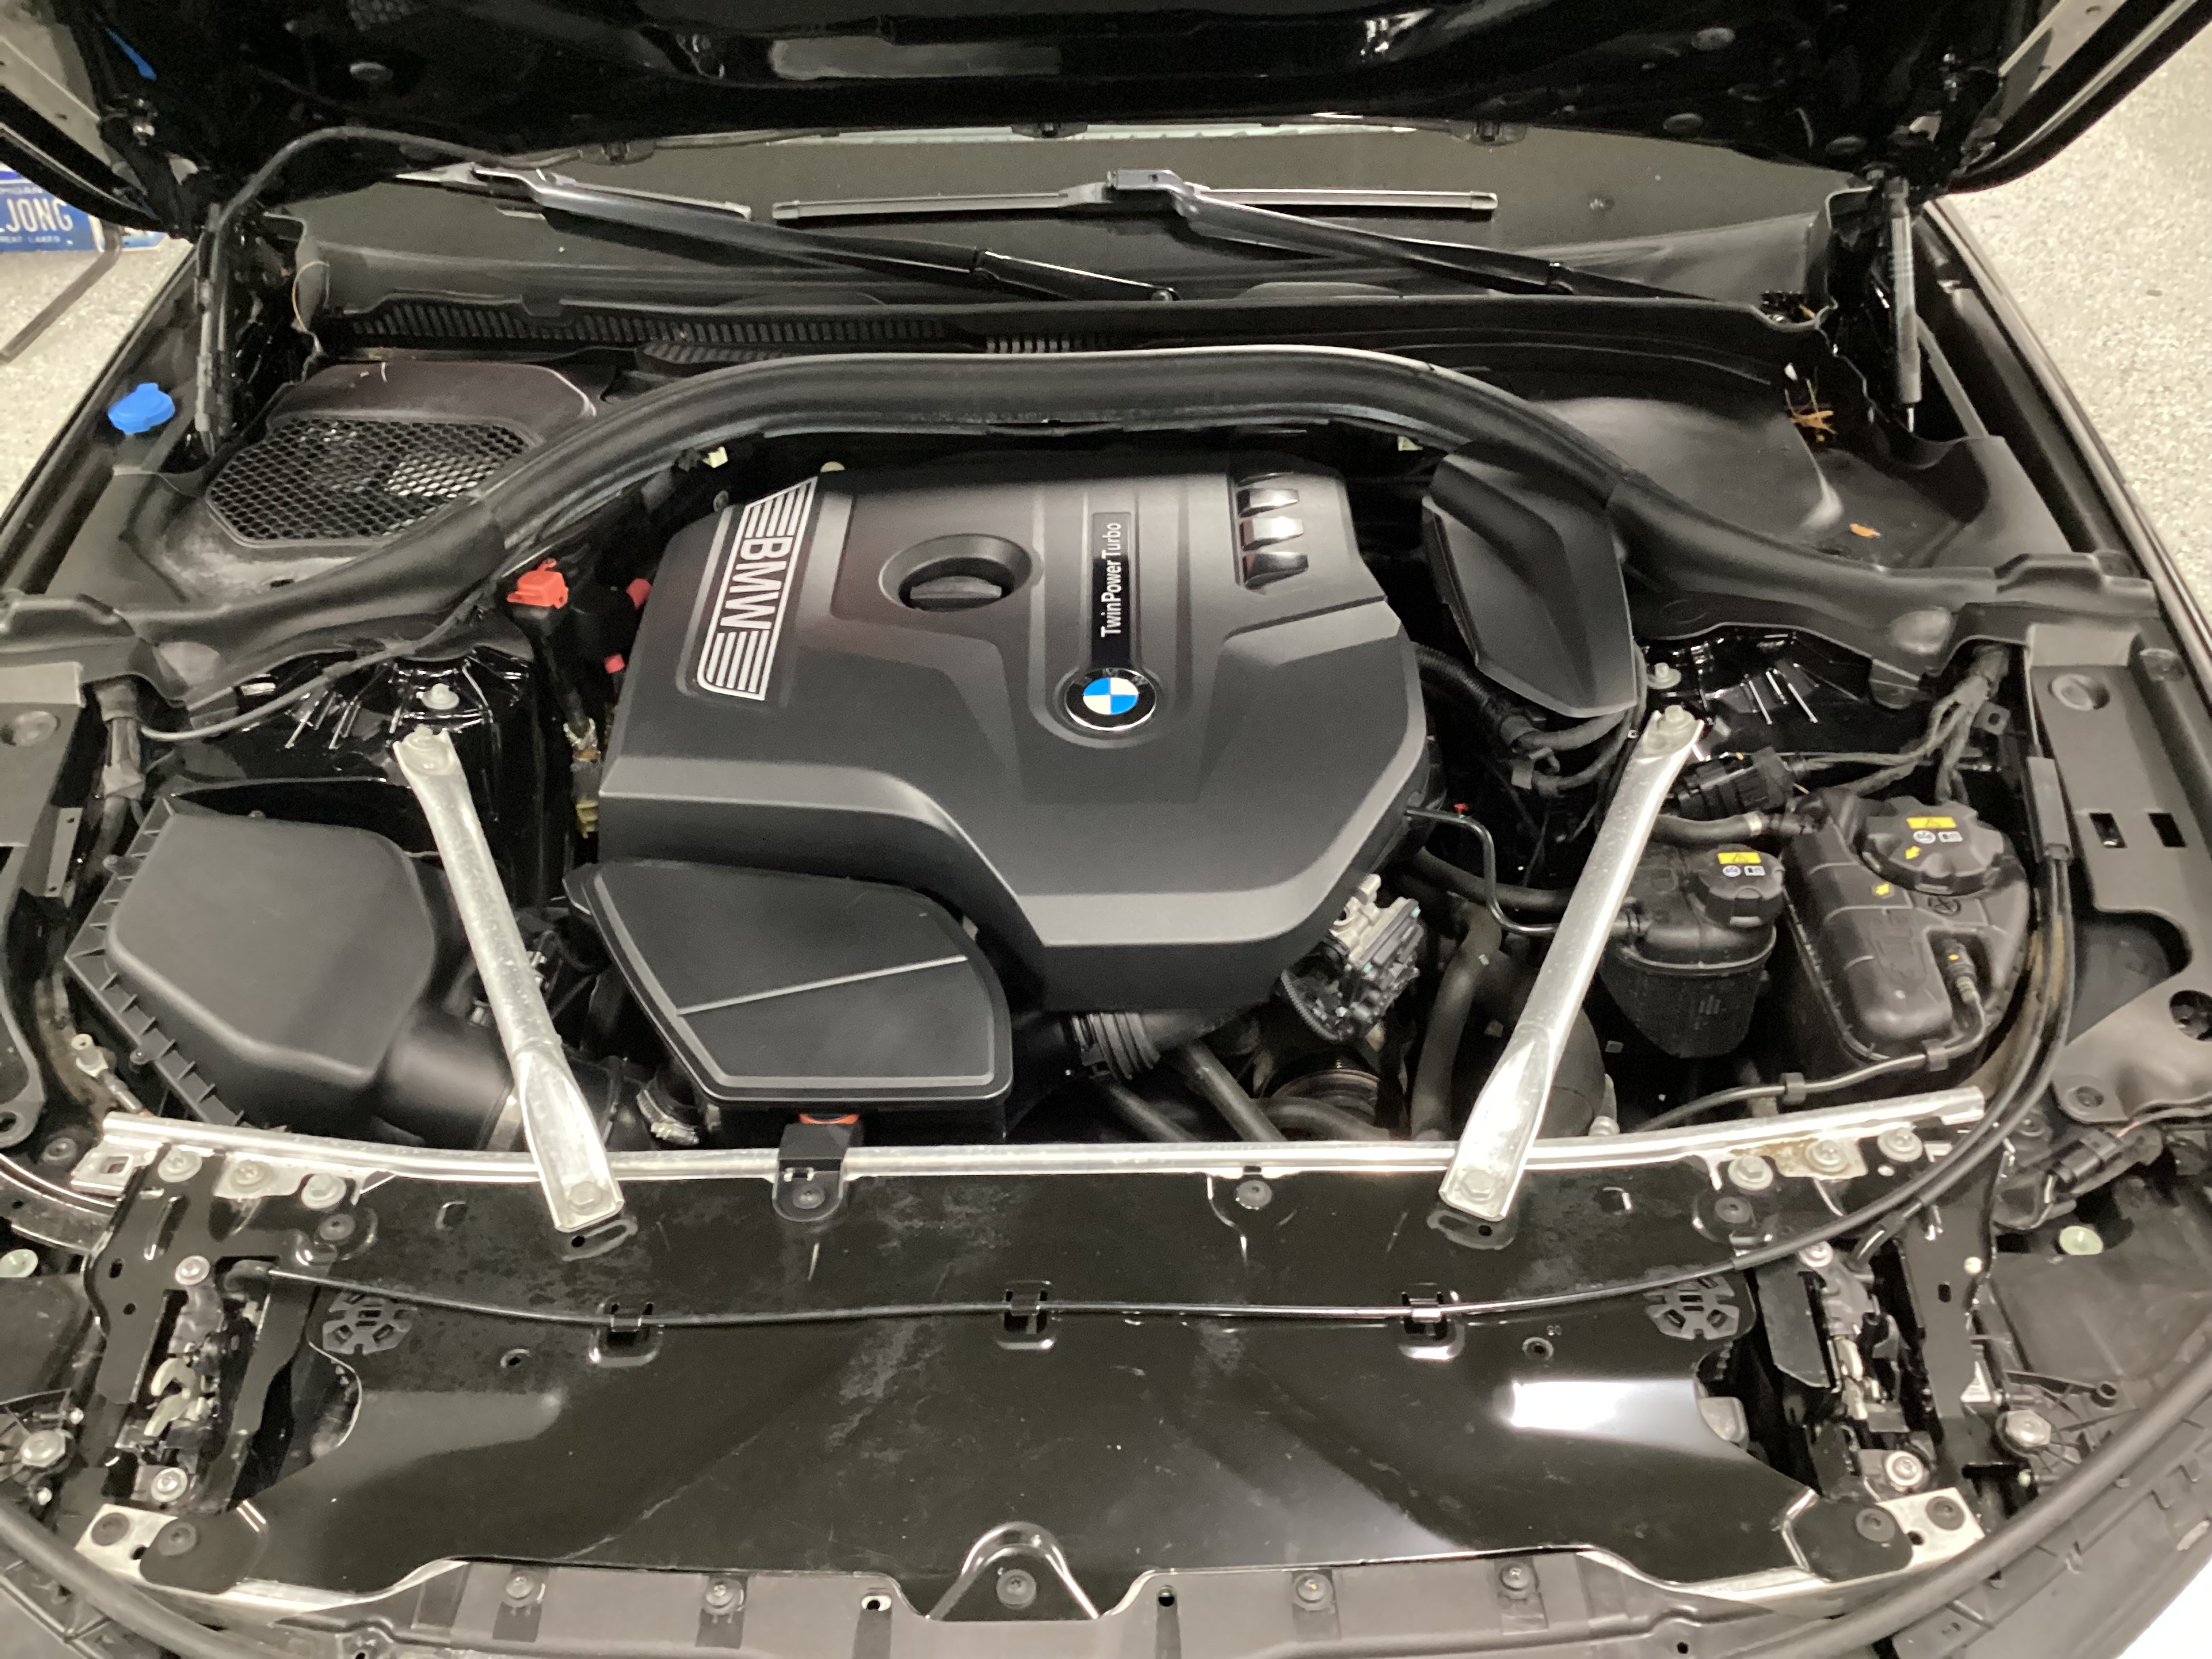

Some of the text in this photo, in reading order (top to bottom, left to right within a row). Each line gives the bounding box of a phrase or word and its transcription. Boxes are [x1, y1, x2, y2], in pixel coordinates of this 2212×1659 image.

[5, 198, 73, 232] JONG
[720, 535, 794, 630] BMW
[1101, 522, 1122, 638] TwinPower Turbo
